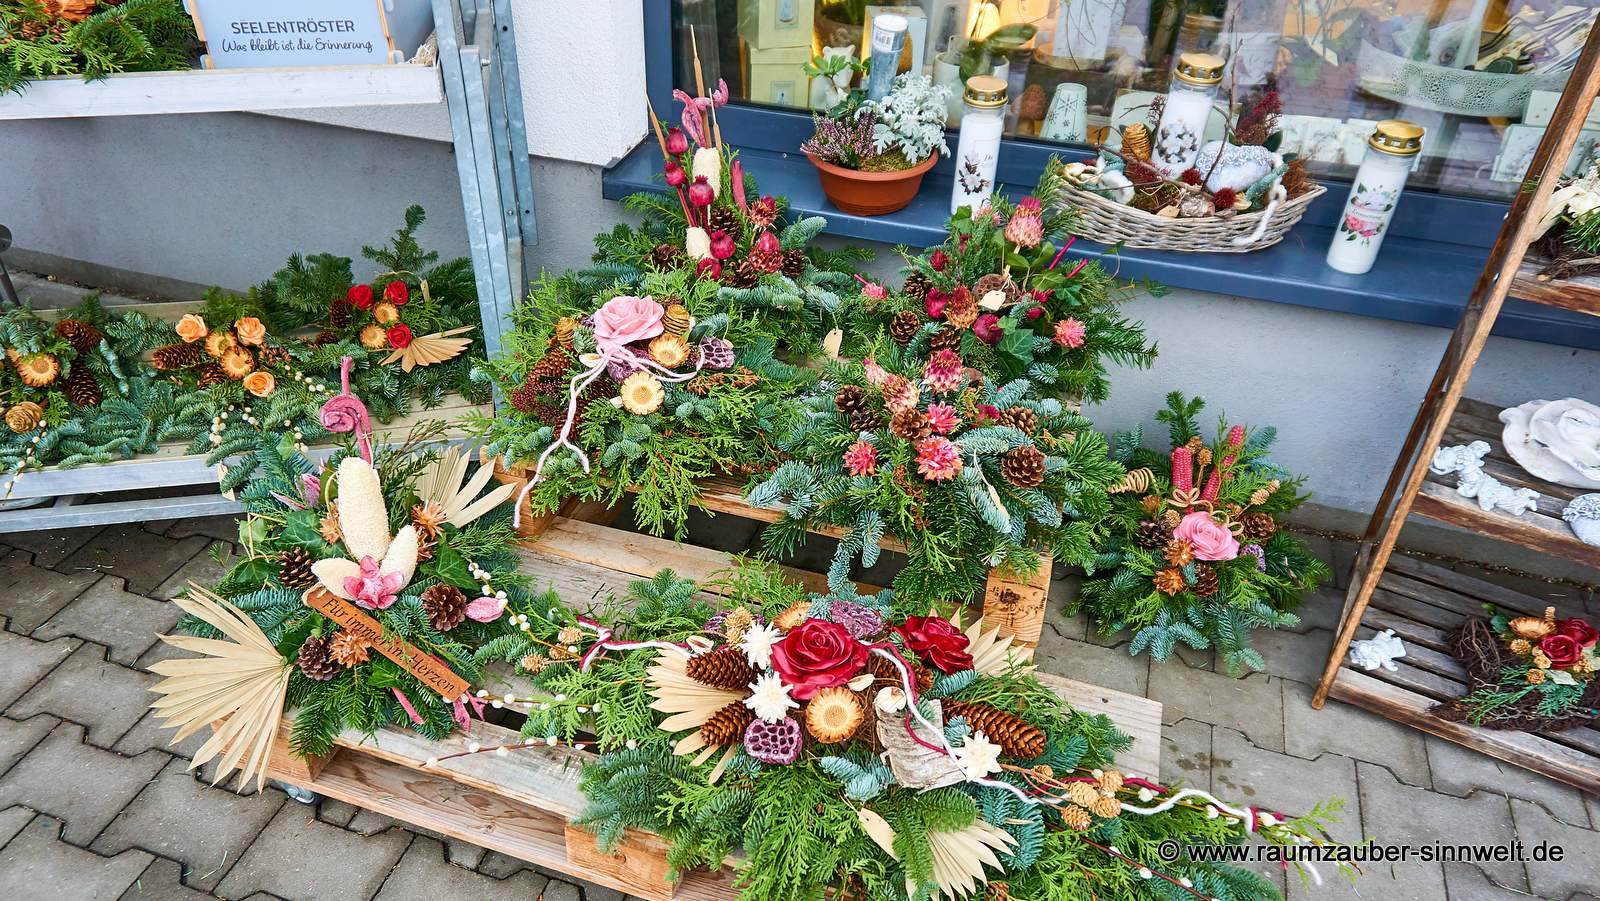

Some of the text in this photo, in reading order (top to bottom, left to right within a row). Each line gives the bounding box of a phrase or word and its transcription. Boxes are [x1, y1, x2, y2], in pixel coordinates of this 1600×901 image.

[231, 18, 355, 34] SEELENTRÖSTER
[222, 37, 373, 53] Was bleibt ist die Erinnerung
[321, 598, 349, 618] Für
[345, 613, 391, 646] immer
[407, 653, 455, 693] Herzen
